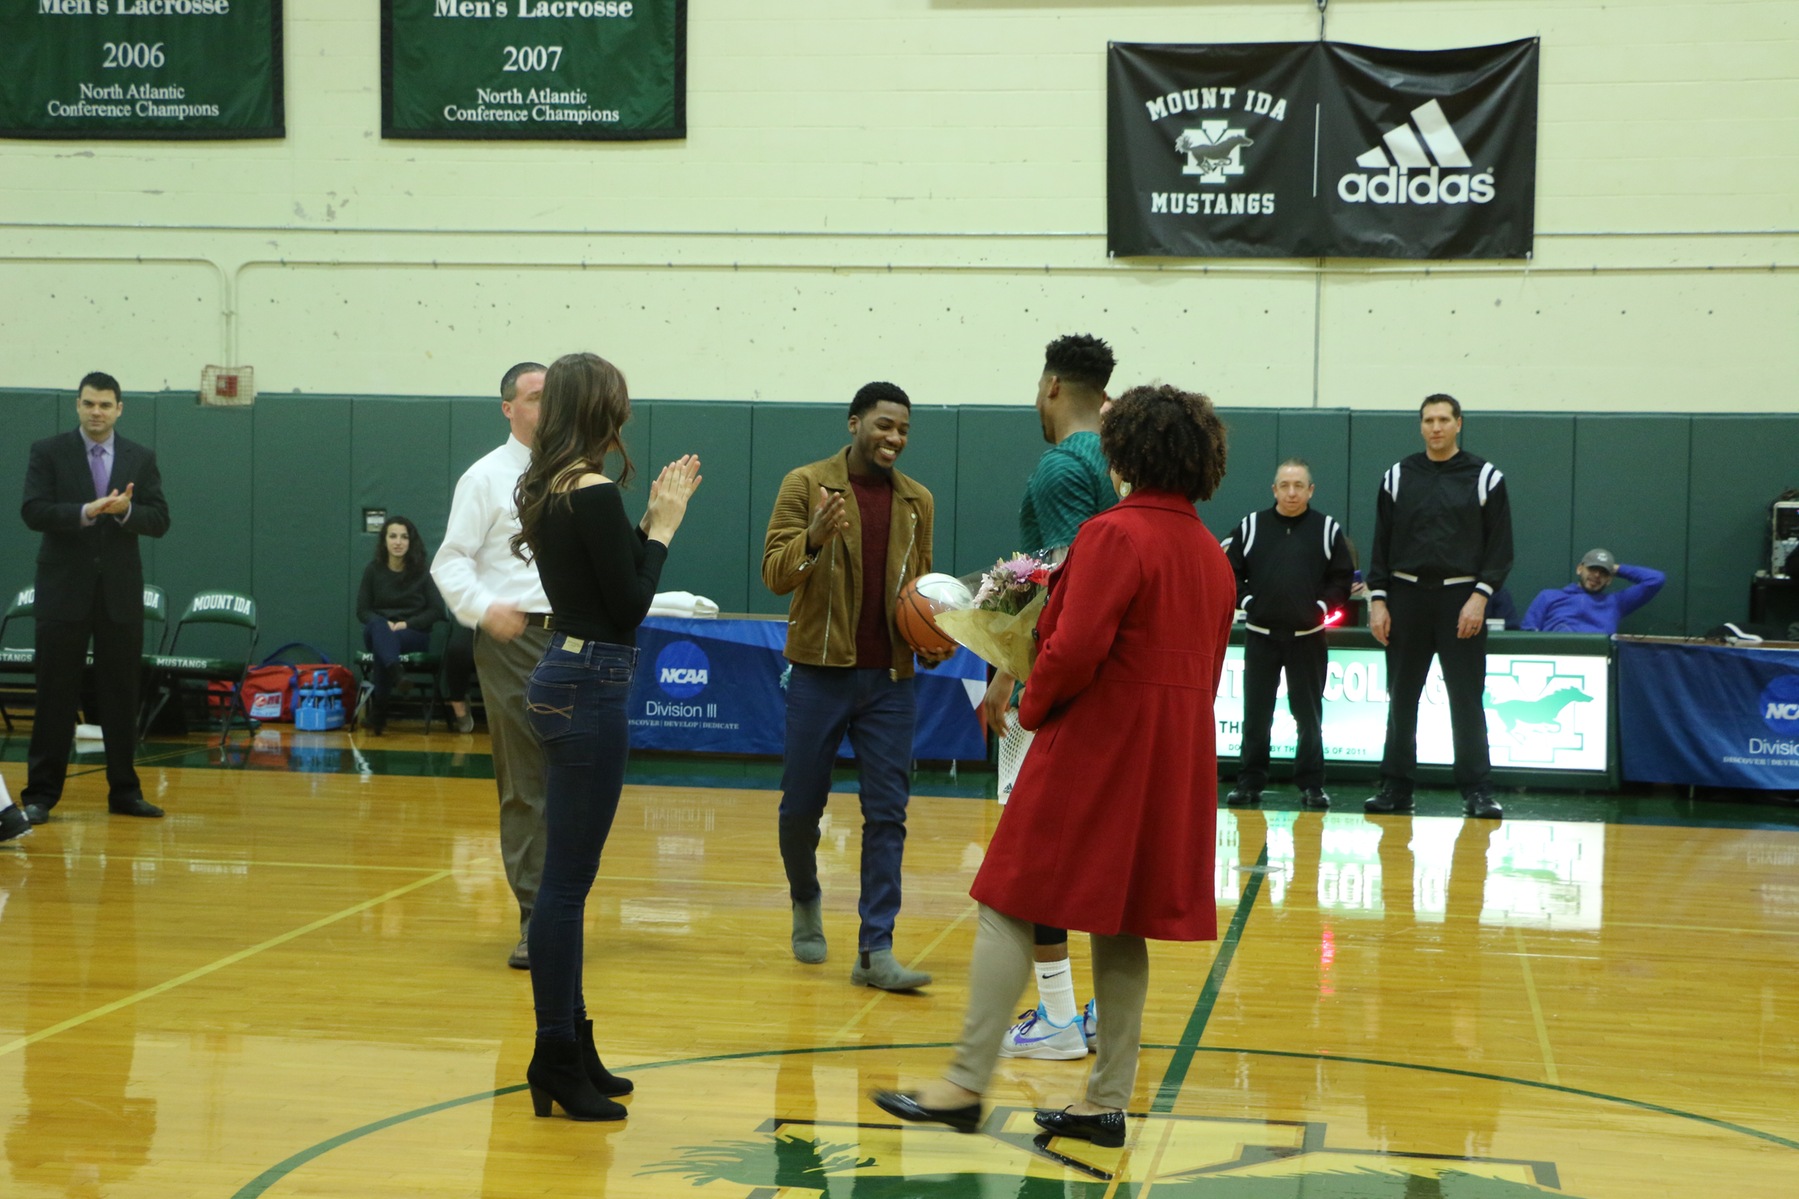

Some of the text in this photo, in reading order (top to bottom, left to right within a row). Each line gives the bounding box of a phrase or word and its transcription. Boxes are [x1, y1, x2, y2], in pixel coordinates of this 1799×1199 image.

[116, 0, 229, 15] Lacrosse
[517, 0, 633, 18] Lacrosse
[102, 42, 165, 68] 2006
[502, 46, 563, 71] 2007
[79, 83, 185, 99] North Atlantic
[476, 88, 587, 104] North Atlantic
[47, 100, 219, 120] Conference Champions
[1145, 87, 1287, 121] MOUNT IDA
[443, 105, 620, 124] Conference Champions
[1337, 165, 1495, 204] adidas
[1151, 192, 1275, 214] MUSTANGS
[192, 594, 252, 615] MOUNT IDA
[156, 658, 208, 669] MUSTANGS
[660, 668, 708, 684] NCAA
[646, 700, 717, 718] Division III
[1765, 703, 1799, 720] NC
[663, 720, 699, 728] DEVELOP
[702, 721, 740, 729] DEDICATE
[1332, 747, 1343, 755] OF
